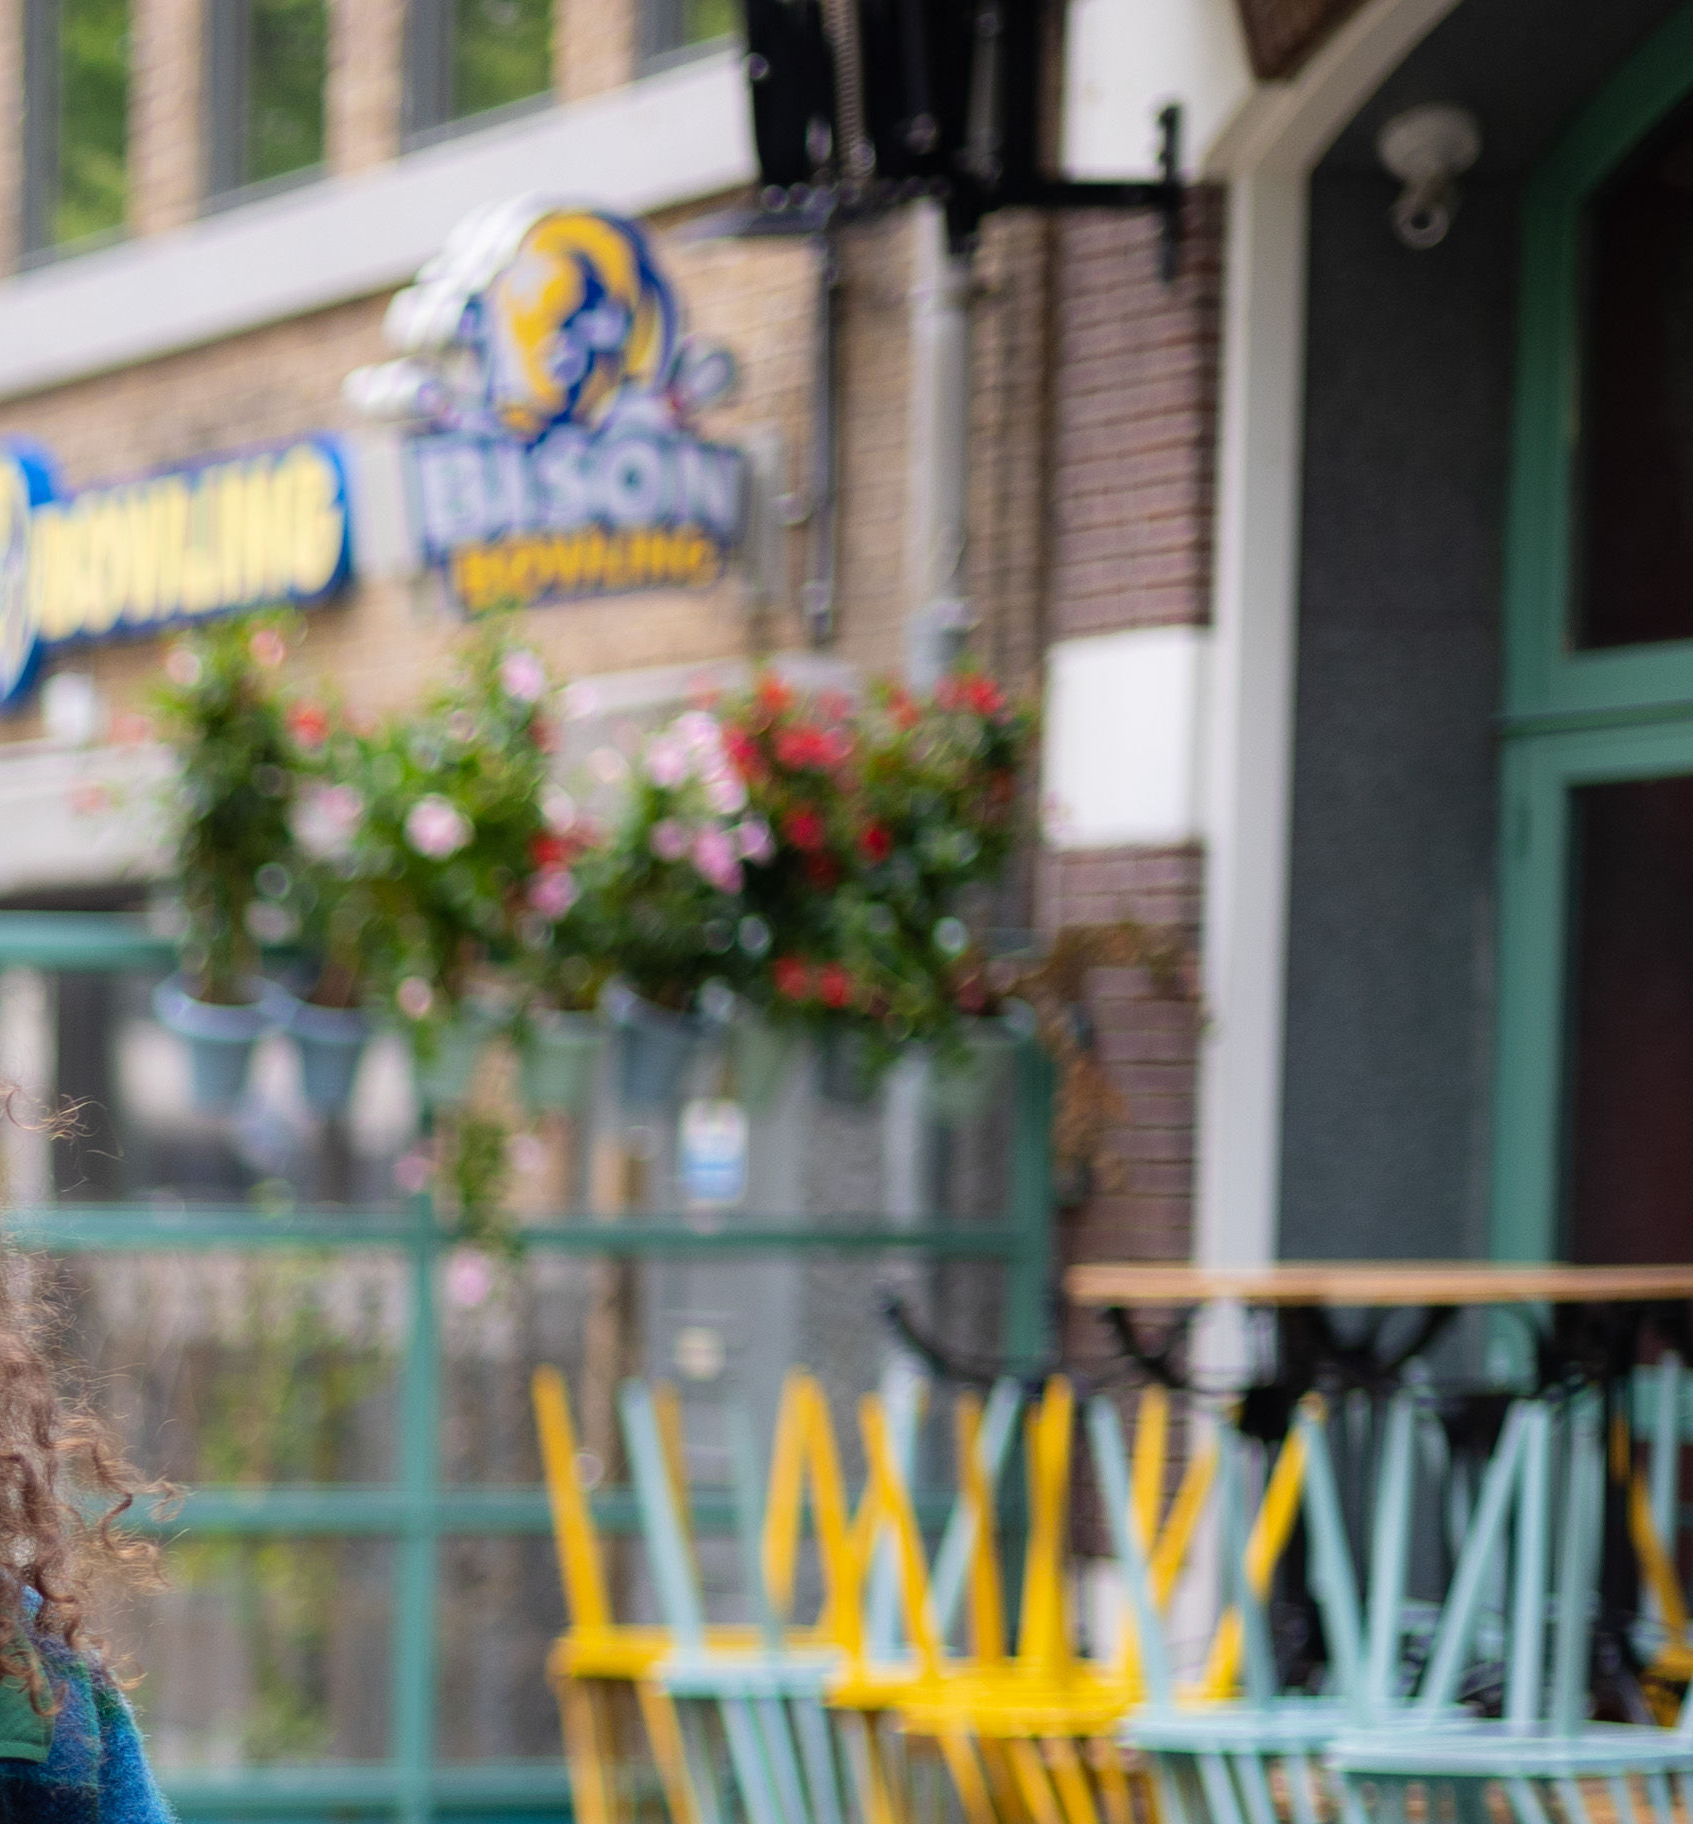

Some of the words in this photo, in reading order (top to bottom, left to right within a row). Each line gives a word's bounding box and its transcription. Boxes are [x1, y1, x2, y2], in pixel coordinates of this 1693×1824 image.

[417, 434, 740, 541] BISON
[31, 448, 344, 642] BOWLING
[454, 524, 715, 608] BOWLING
